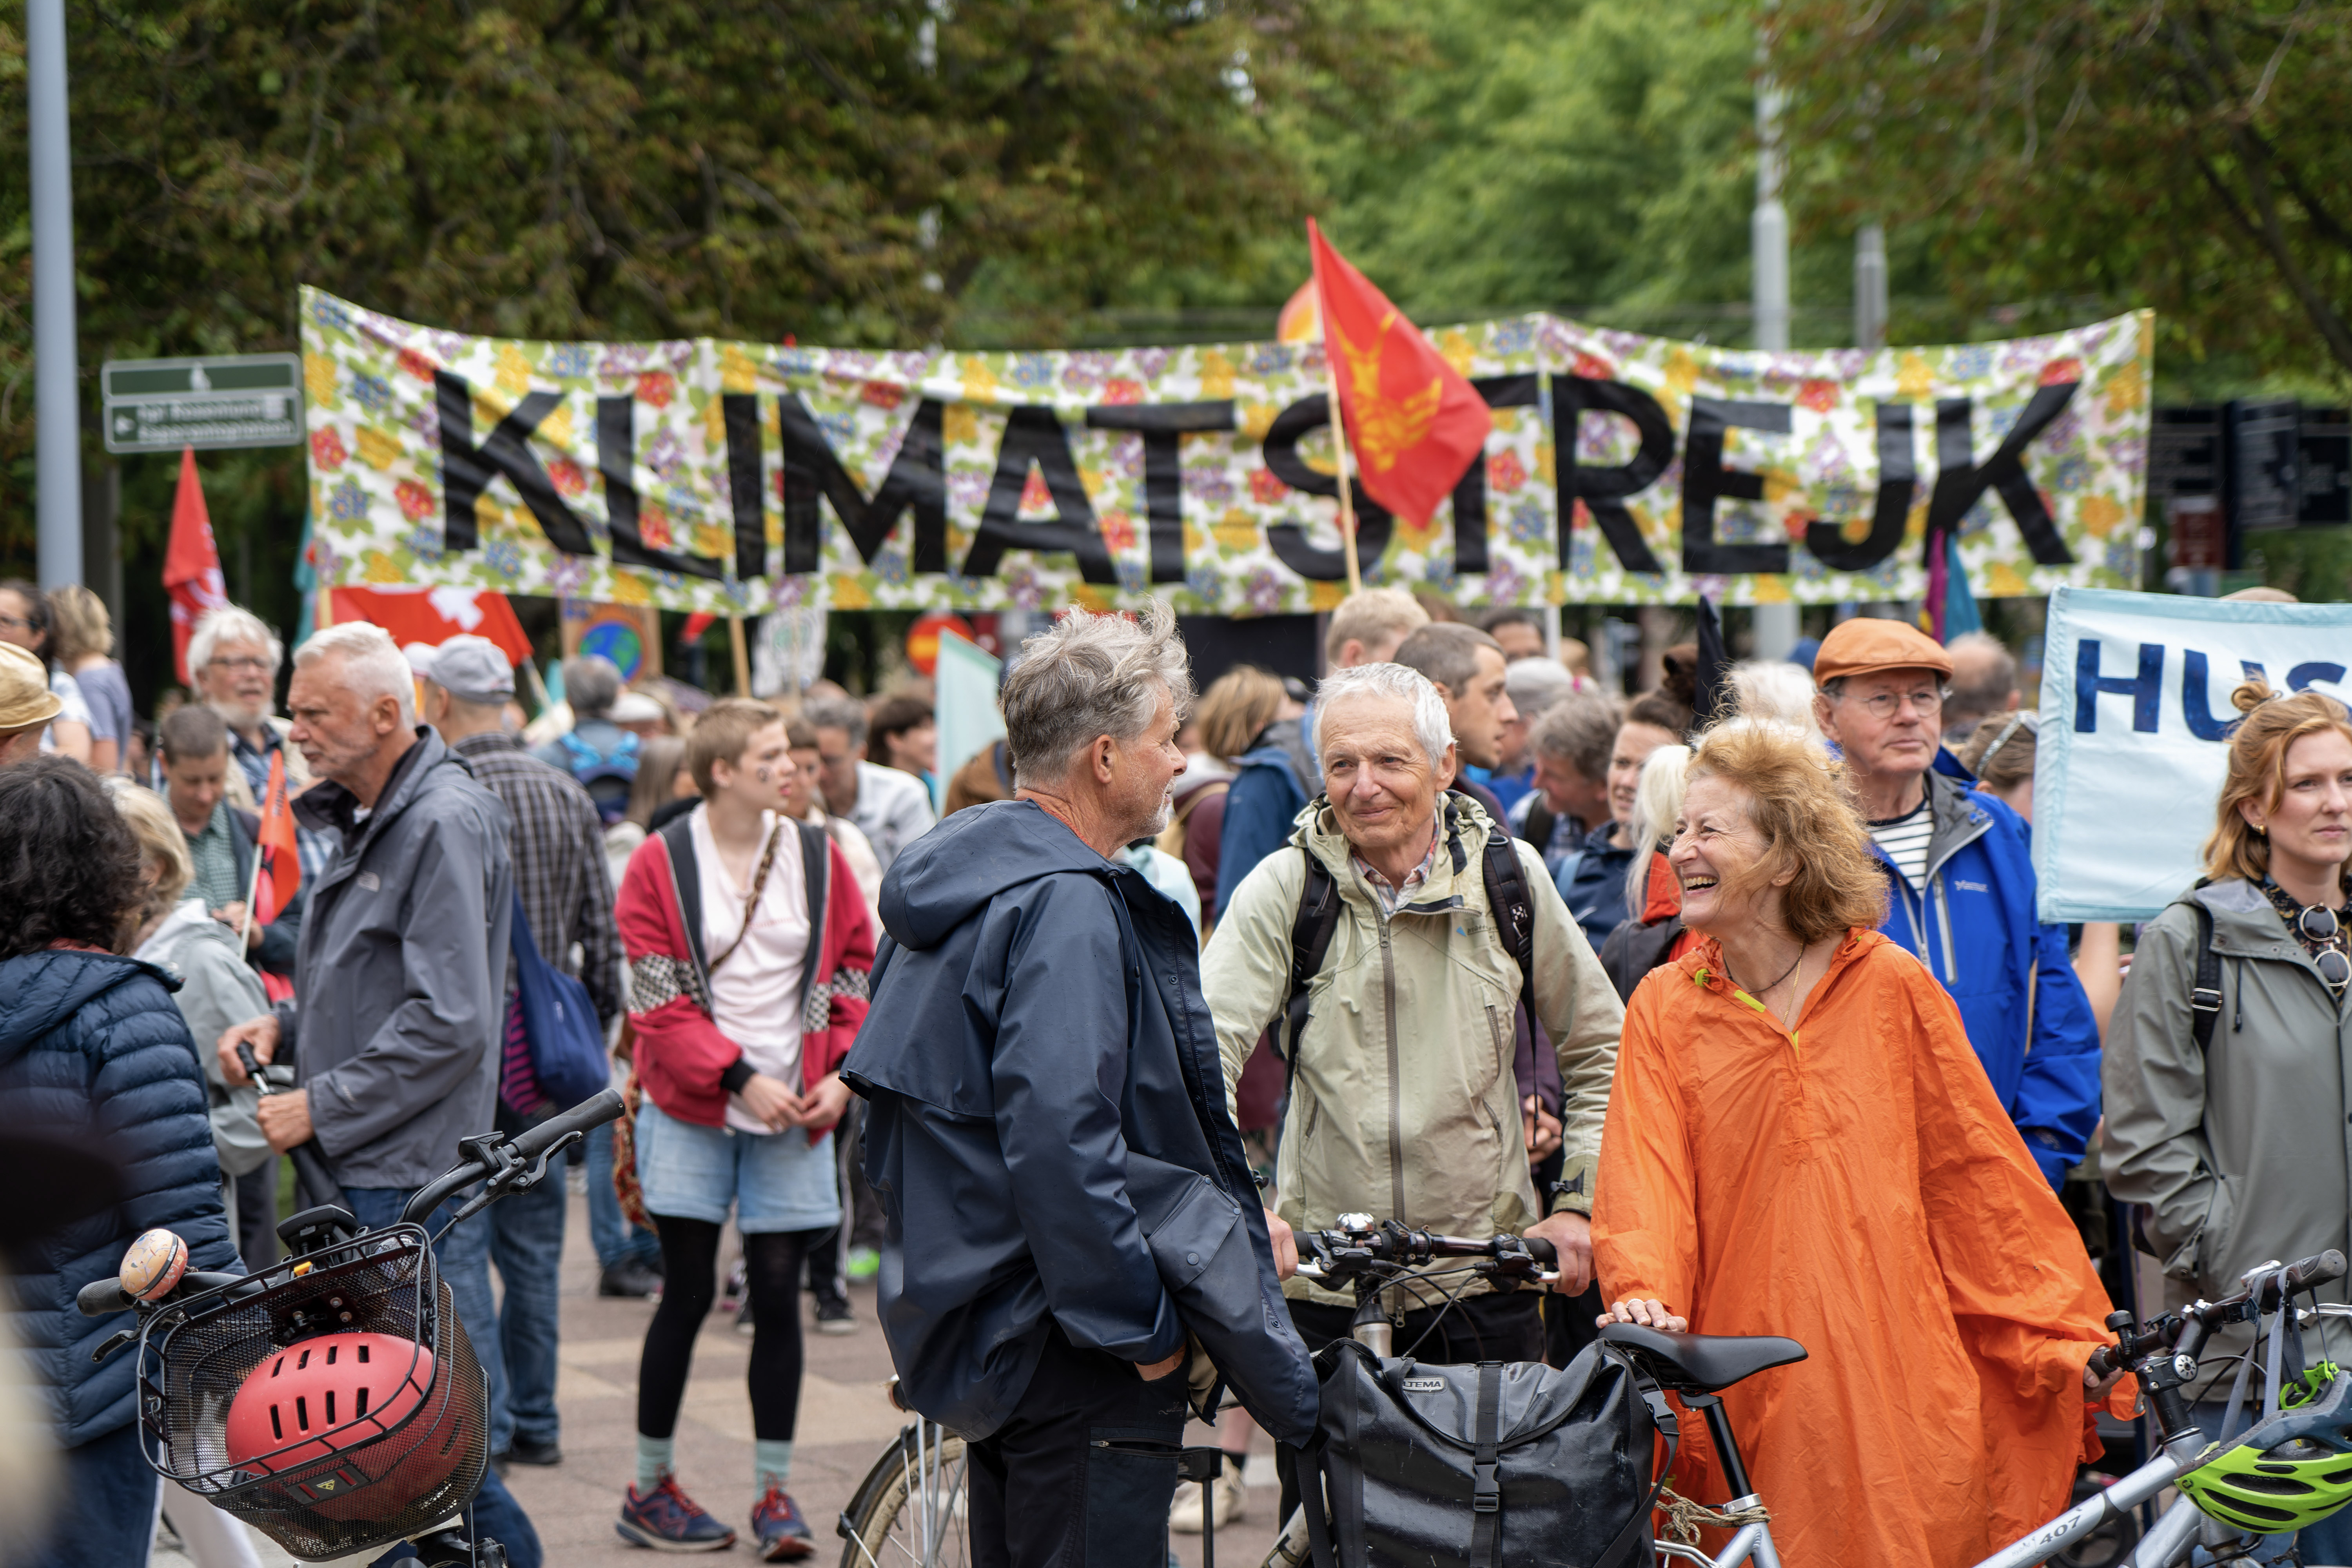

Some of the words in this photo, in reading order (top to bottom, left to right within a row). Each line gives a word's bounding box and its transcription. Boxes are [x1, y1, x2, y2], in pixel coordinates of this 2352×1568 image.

[434, 369, 2080, 583] KLIMATSTREJK
[167, 1244, 176, 1262] BASIL
[2040, 1515, 2081, 1545] 407
